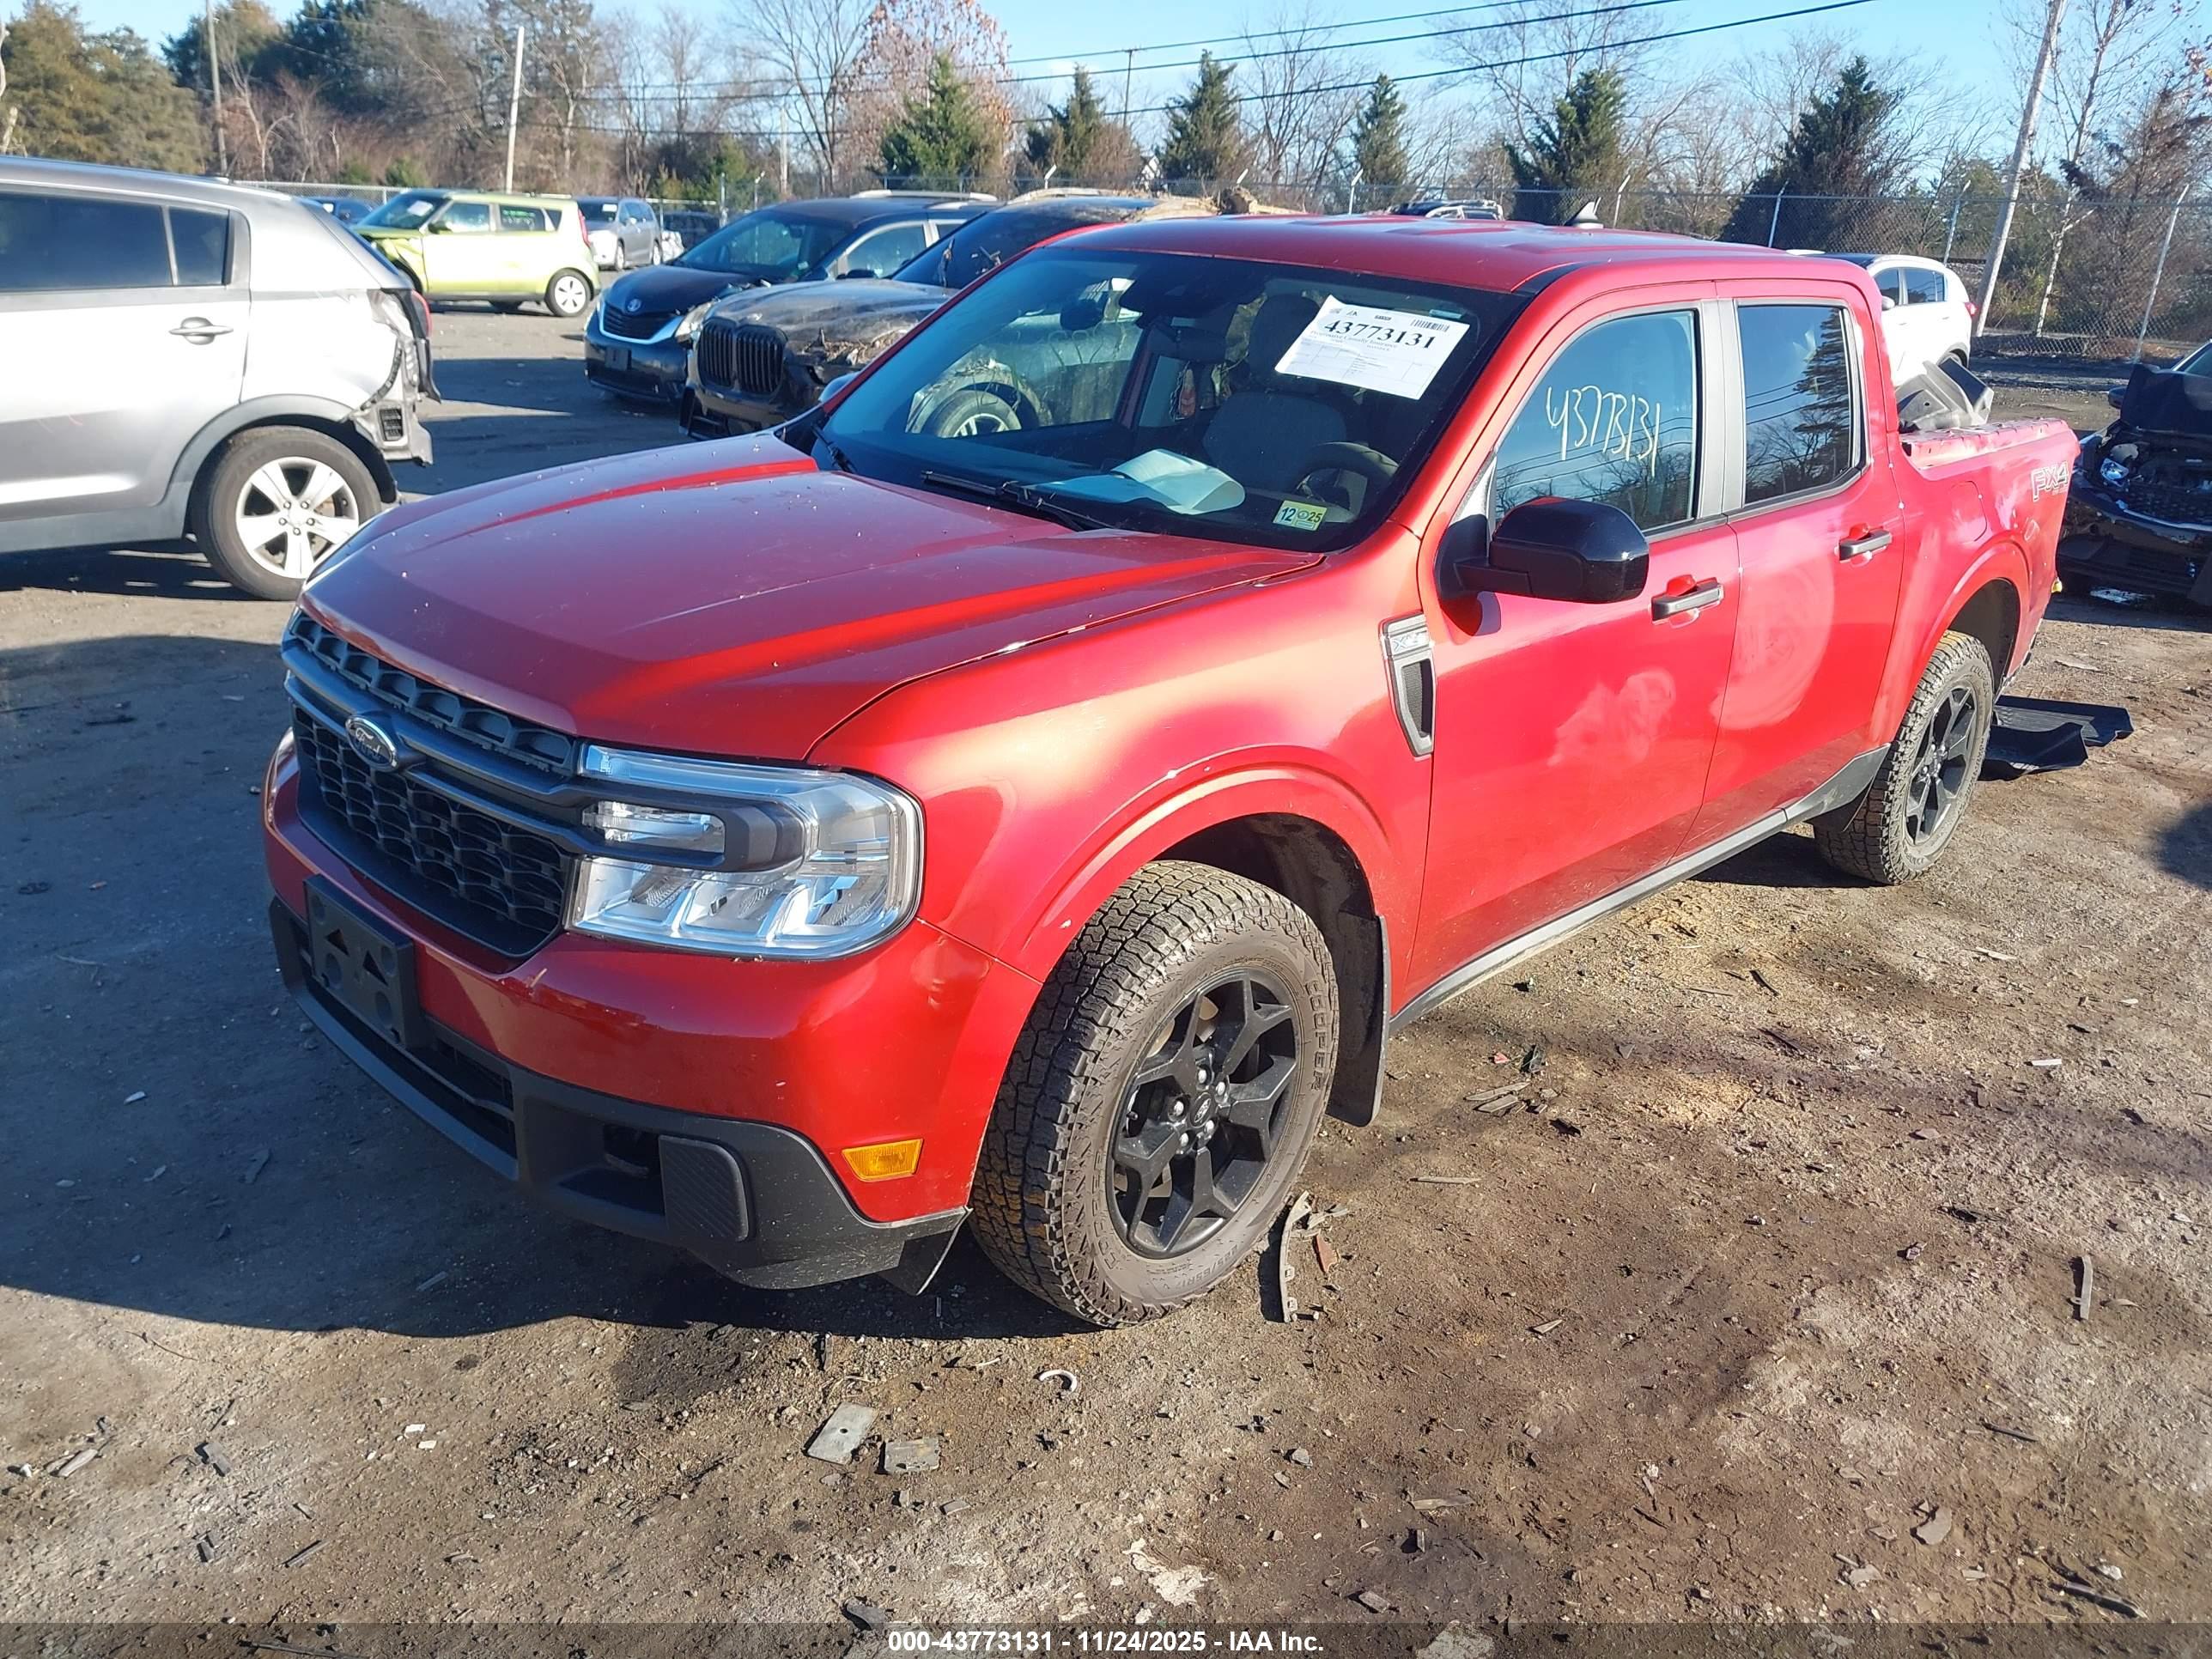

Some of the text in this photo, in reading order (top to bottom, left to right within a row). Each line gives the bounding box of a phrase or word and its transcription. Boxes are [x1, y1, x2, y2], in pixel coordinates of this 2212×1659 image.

[1324, 319, 1436, 349] 43773131
[1547, 386, 1661, 477] 43773131
[2031, 461, 2068, 502] FX4
[1281, 507, 1322, 523] 12 25
[355, 726, 383, 762] Ford
[1303, 980, 1327, 1091] COOPER
